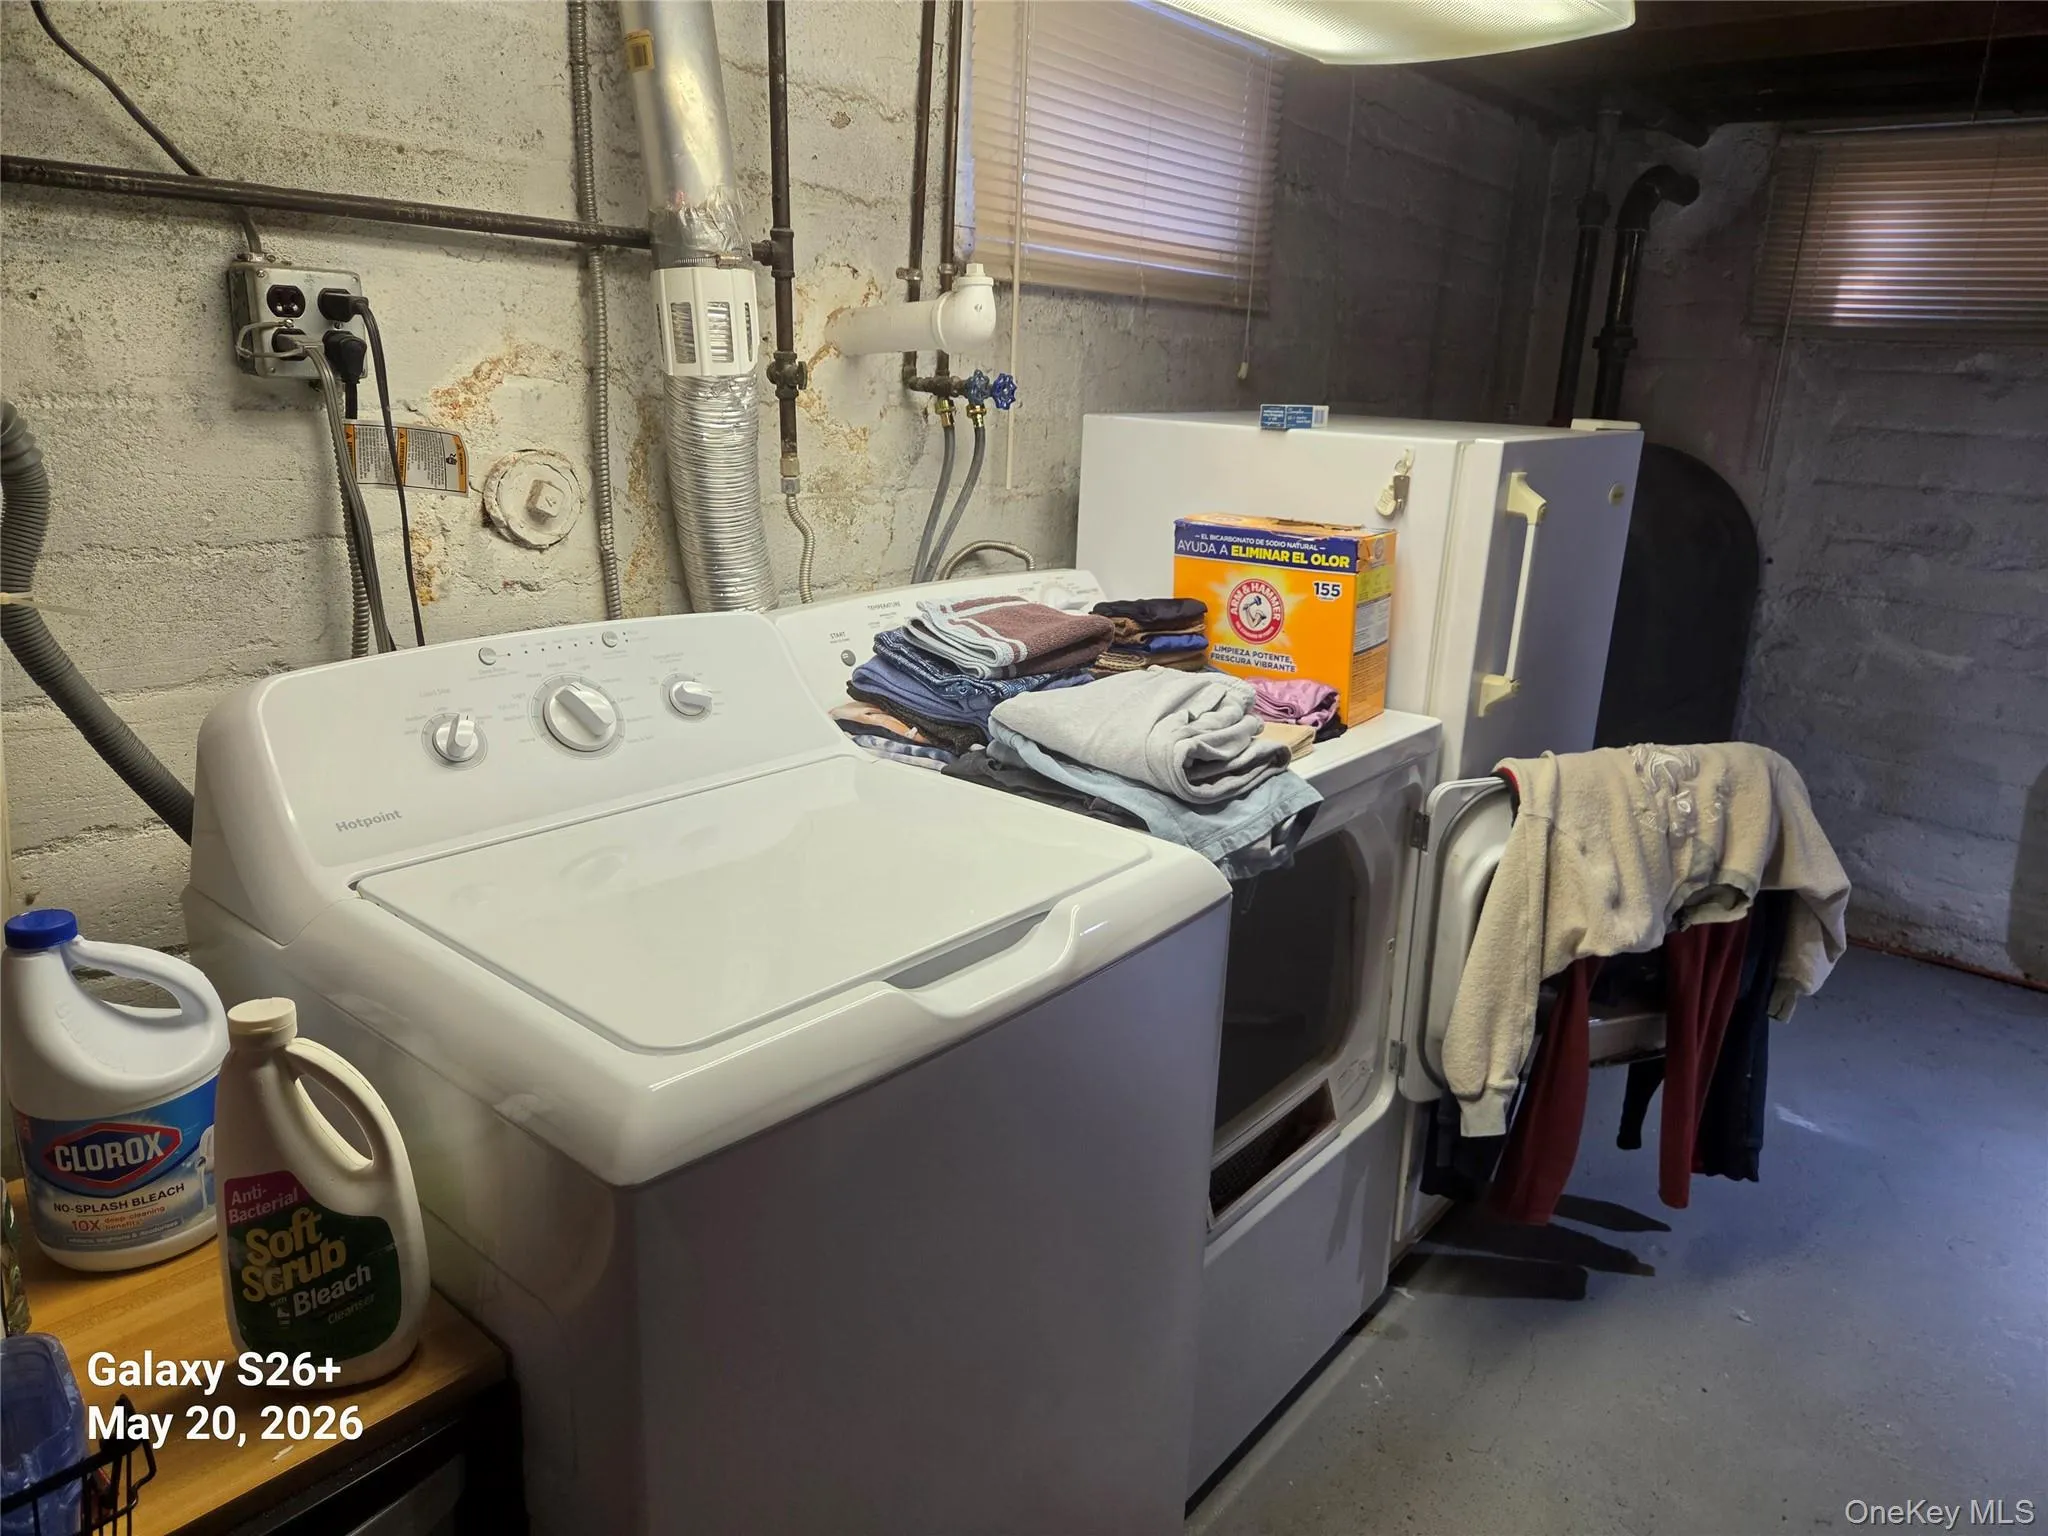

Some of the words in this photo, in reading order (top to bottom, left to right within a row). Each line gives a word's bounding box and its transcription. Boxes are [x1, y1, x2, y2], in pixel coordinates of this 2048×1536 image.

[1177, 539, 1217, 554] AYUDA
[1218, 545, 1229, 555] A
[1231, 545, 1290, 563] ELIMINAR
[1291, 552, 1308, 564] EL
[1310, 553, 1350, 568] OLOR
[1200, 533, 1209, 541] EL
[1209, 535, 1255, 545] BICARBONATO
[1265, 540, 1285, 548] SODIO
[1287, 542, 1319, 551] NATURAL
[1230, 589, 1244, 615] ARM
[1242, 585, 1251, 594] &
[1250, 582, 1281, 621] HAMMER
[1313, 582, 1341, 598] 155
[829, 631, 846, 640] START
[1210, 652, 1251, 666] FRESCURA
[1254, 659, 1296, 673] VIBRANTE
[1213, 645, 1251, 657] LIMPIEZA
[1252, 651, 1293, 665] POTENTE,
[335, 809, 402, 833] Hotpoint
[53, 1130, 166, 1173] CLOROX
[53, 1199, 129, 1214] NO-SPLASH
[132, 1183, 185, 1206] BLEACH
[228, 1187, 299, 1224] Bacterial
[231, 1183, 268, 1206] Anti-
[71, 1218, 101, 1233] 10X
[129, 1206, 166, 1220] cleaning
[245, 1207, 323, 1267] Soft
[241, 1237, 348, 1302] Scrub
[292, 1264, 372, 1318] Bleach
